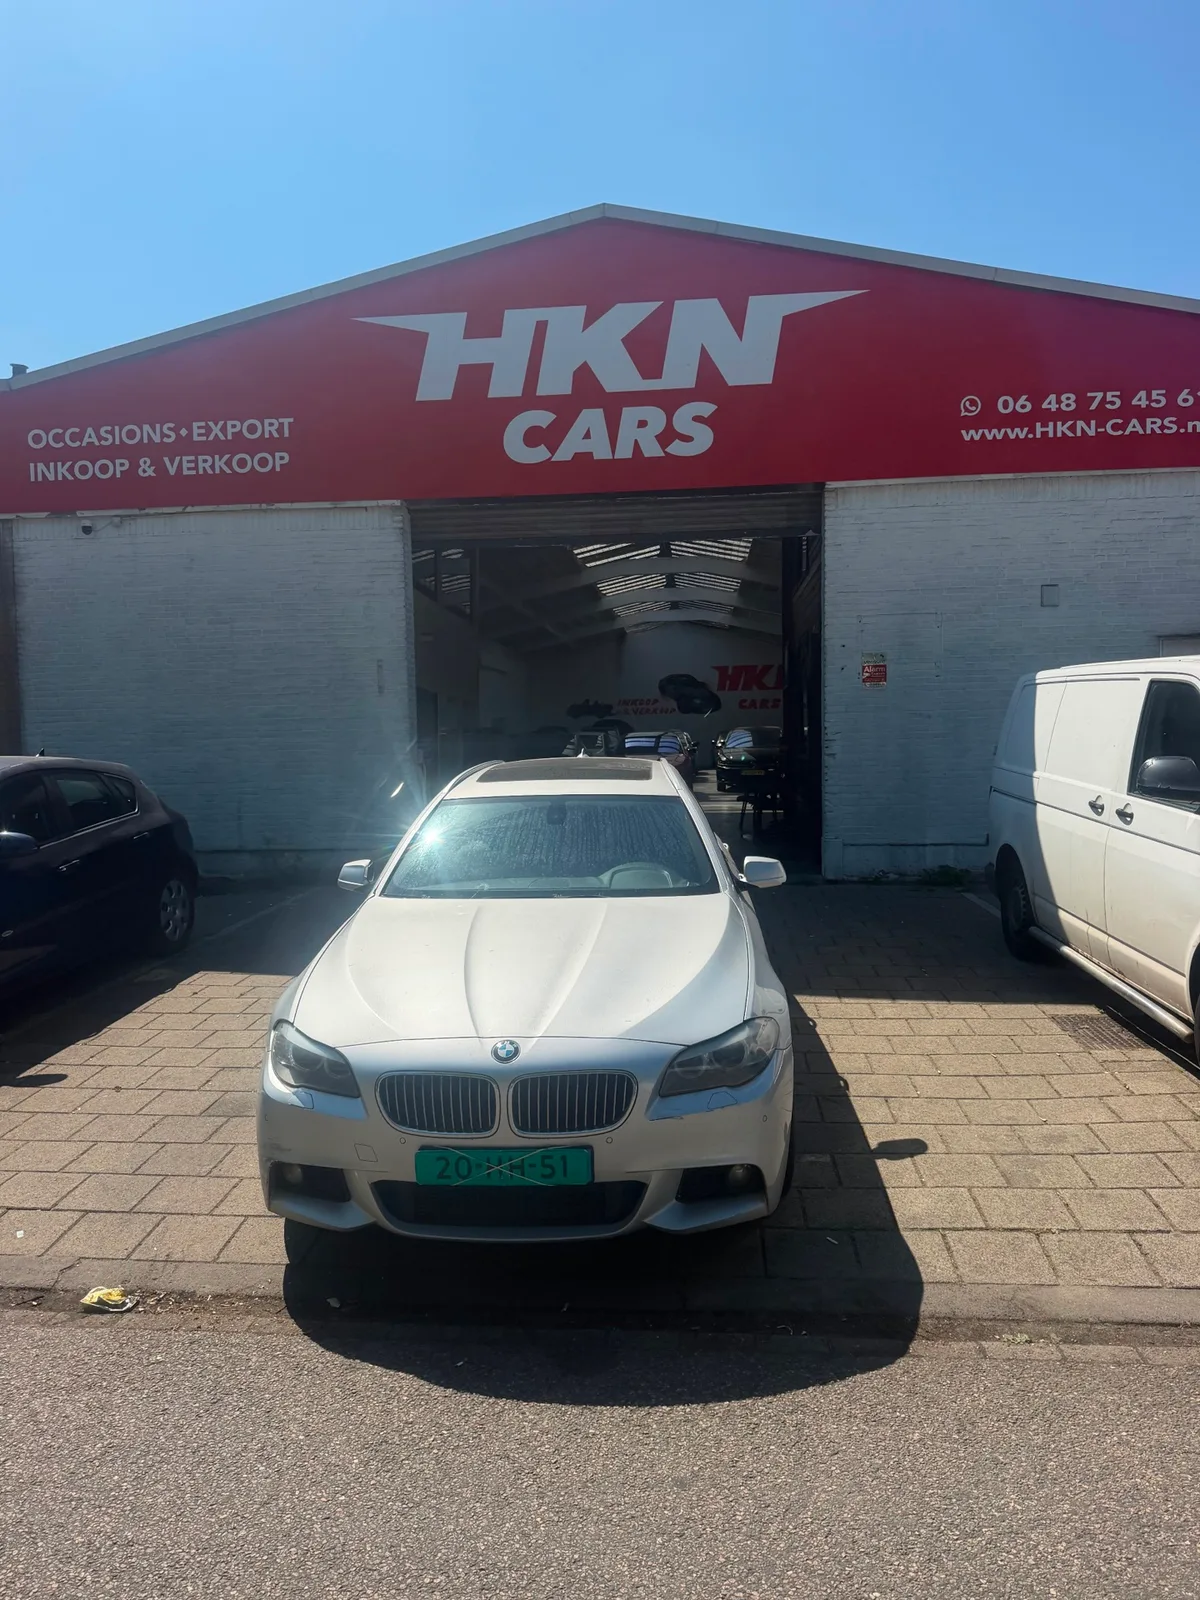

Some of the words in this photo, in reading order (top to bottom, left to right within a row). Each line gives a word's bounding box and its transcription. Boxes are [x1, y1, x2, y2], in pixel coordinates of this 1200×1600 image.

[350, 289, 870, 401] HKN
[997, 395, 1032, 414] 06
[1041, 393, 1077, 411] 48
[1087, 391, 1122, 410] 75
[1131, 389, 1167, 408] 45
[1177, 388, 1200, 407] 6
[192, 418, 294, 441] EXPORT
[503, 402, 718, 464] CARS
[29, 457, 129, 482] INKOOP
[138, 457, 156, 477] &
[163, 452, 289, 476] VERKOOP
[738, 698, 781, 709] CARS
